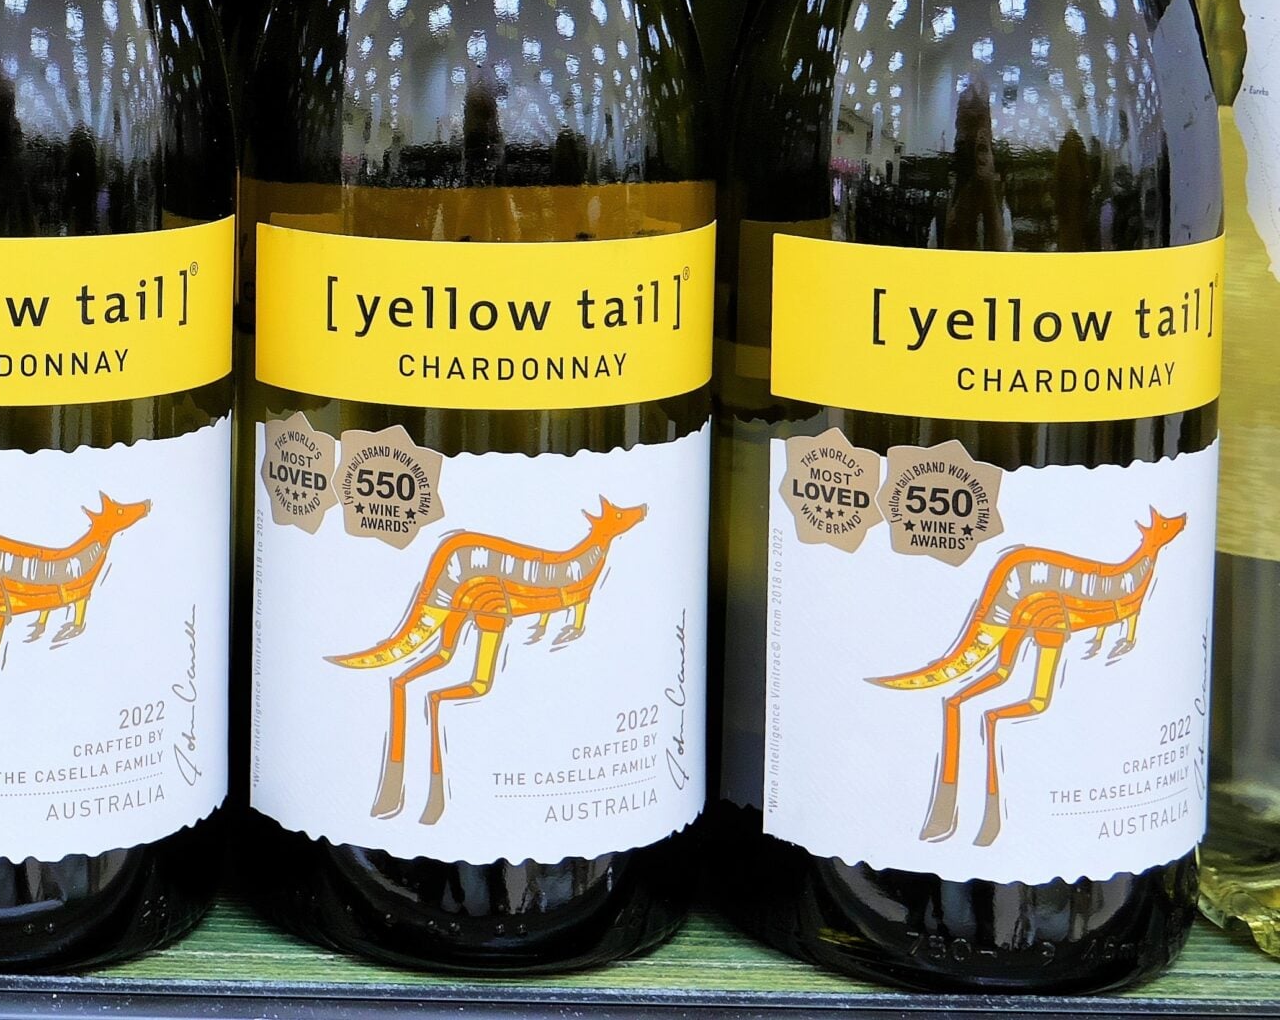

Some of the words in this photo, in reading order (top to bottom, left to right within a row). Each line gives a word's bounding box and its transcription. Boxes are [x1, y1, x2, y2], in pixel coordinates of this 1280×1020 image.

[398, 352, 627, 381] CHARDONNAY
[957, 361, 1175, 393] CHARDONNAY
[274, 431, 287, 450] THE
[287, 431, 322, 460] WORLD'S
[281, 450, 313, 468] MOST
[363, 446, 390, 460] BRAND
[393, 448, 412, 468] WON
[269, 462, 327, 491] LOVED
[409, 463, 429, 490] MORE
[800, 449, 818, 468] THE
[819, 447, 864, 477] WORLD'S
[810, 467, 852, 485] MOST
[912, 462, 945, 477] BRAND
[948, 465, 970, 483] WON
[274, 485, 291, 511] WINE
[356, 469, 416, 501] 550
[792, 479, 870, 509] LOVED
[967, 479, 988, 506] MORE
[369, 503, 400, 518] WINE
[418, 491, 431, 516] THAN
[905, 486, 973, 518] 550
[800, 503, 824, 531] WINE
[920, 519, 956, 535] WINE
[975, 507, 990, 532] THAN
[772, 528, 783, 556] 2022
[772, 561, 782, 572] to
[771, 576, 782, 605] 2018
[770, 610, 782, 637] from
[119, 700, 165, 730] 2022
[616, 704, 659, 733] 2022
[73, 734, 142, 758] CRAFTED
[149, 729, 164, 744] BY
[769, 704, 782, 775] Intelligence
[1160, 715, 1191, 745] 2022
[572, 737, 638, 760] CRAFTED
[643, 733, 657, 747] BY
[1123, 752, 1176, 774] CRAFTED
[1180, 744, 1190, 759] BY
[35, 764, 108, 783] CASELLA
[116, 750, 164, 773] FAMILY
[493, 773, 525, 786] THE
[534, 766, 606, 785] CASELLA
[612, 755, 657, 777] FAMILY
[1050, 790, 1082, 804] THE
[1089, 783, 1151, 801] CASELLA
[1156, 765, 1189, 790] FAMILY
[46, 784, 165, 821] AUSTRALIA
[545, 788, 658, 823] AUSTRALIA
[1098, 800, 1189, 840] AUSTRALIA
